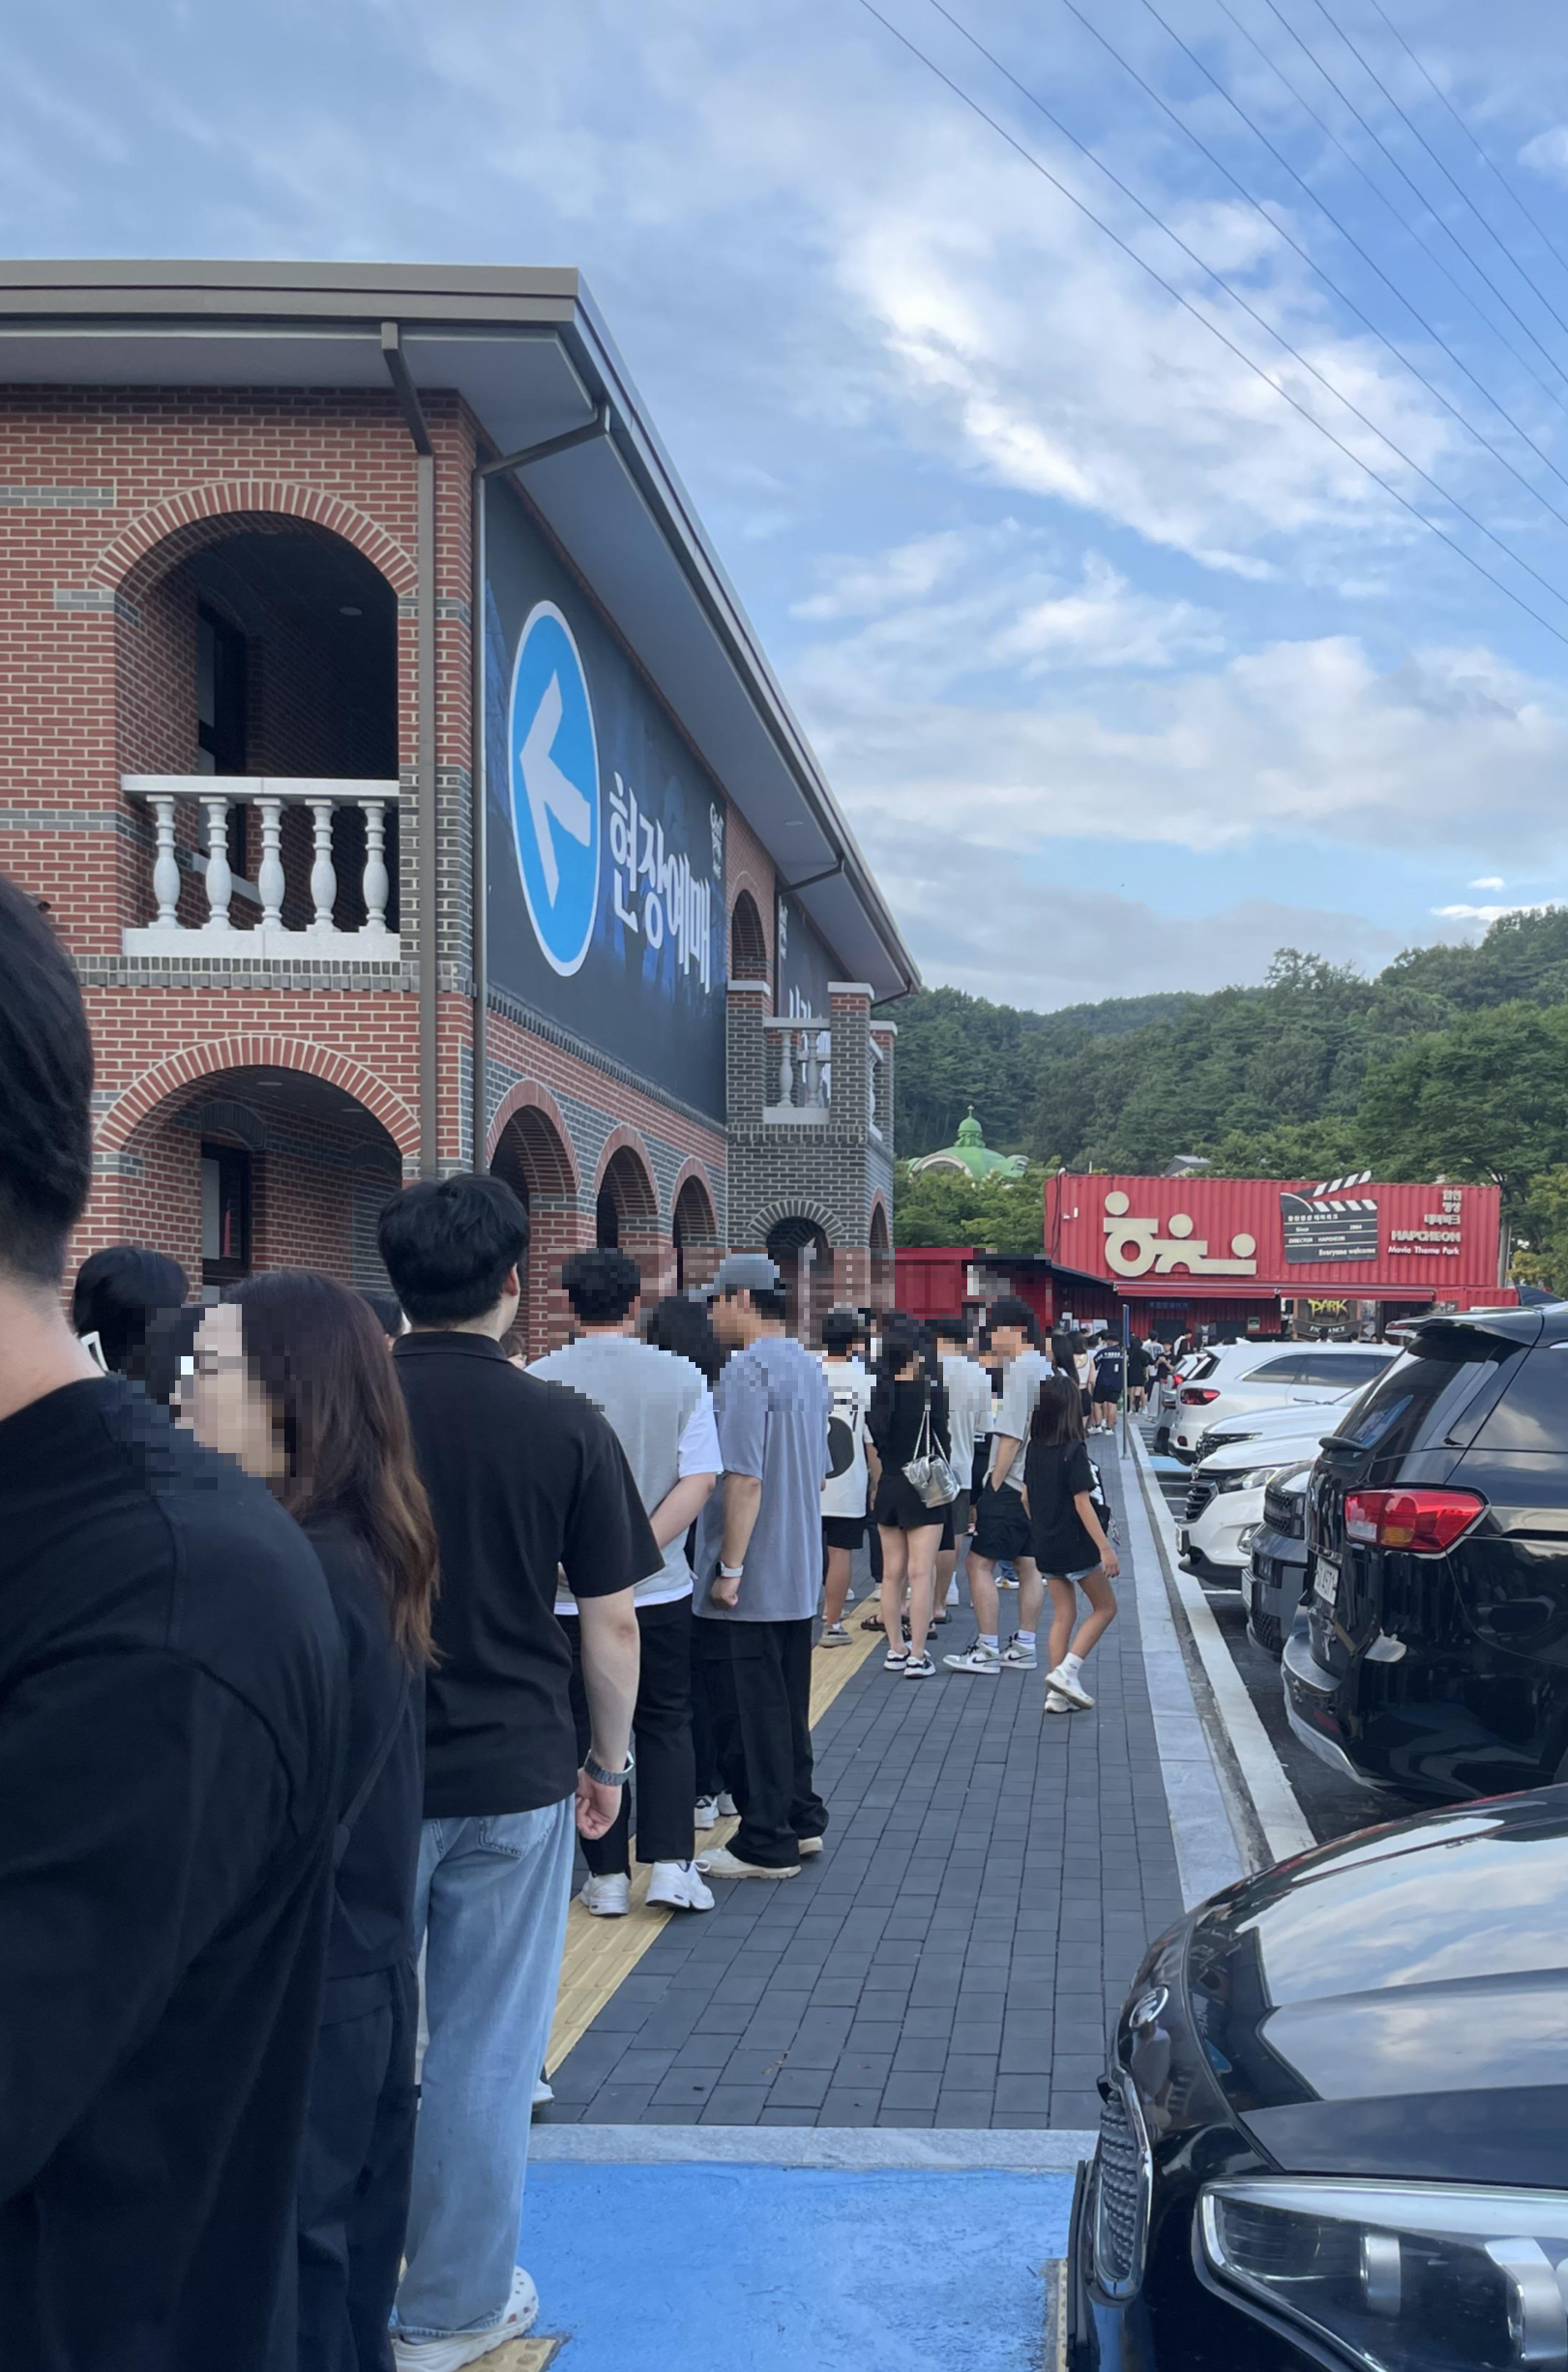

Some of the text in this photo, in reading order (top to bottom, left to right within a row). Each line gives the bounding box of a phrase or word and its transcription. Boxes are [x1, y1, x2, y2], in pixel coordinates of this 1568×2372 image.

[609, 771, 711, 994] 현장예매
[1441, 1201, 1462, 1213] 영상
[1424, 1214, 1462, 1226] 테마파크
[1391, 1230, 1462, 1242] HAPCHEON
[1387, 1245, 1460, 1255] Movie Theme Park
[1308, 1298, 1348, 1318] PARK
[1309, 1325, 1346, 1334] ENANCE
